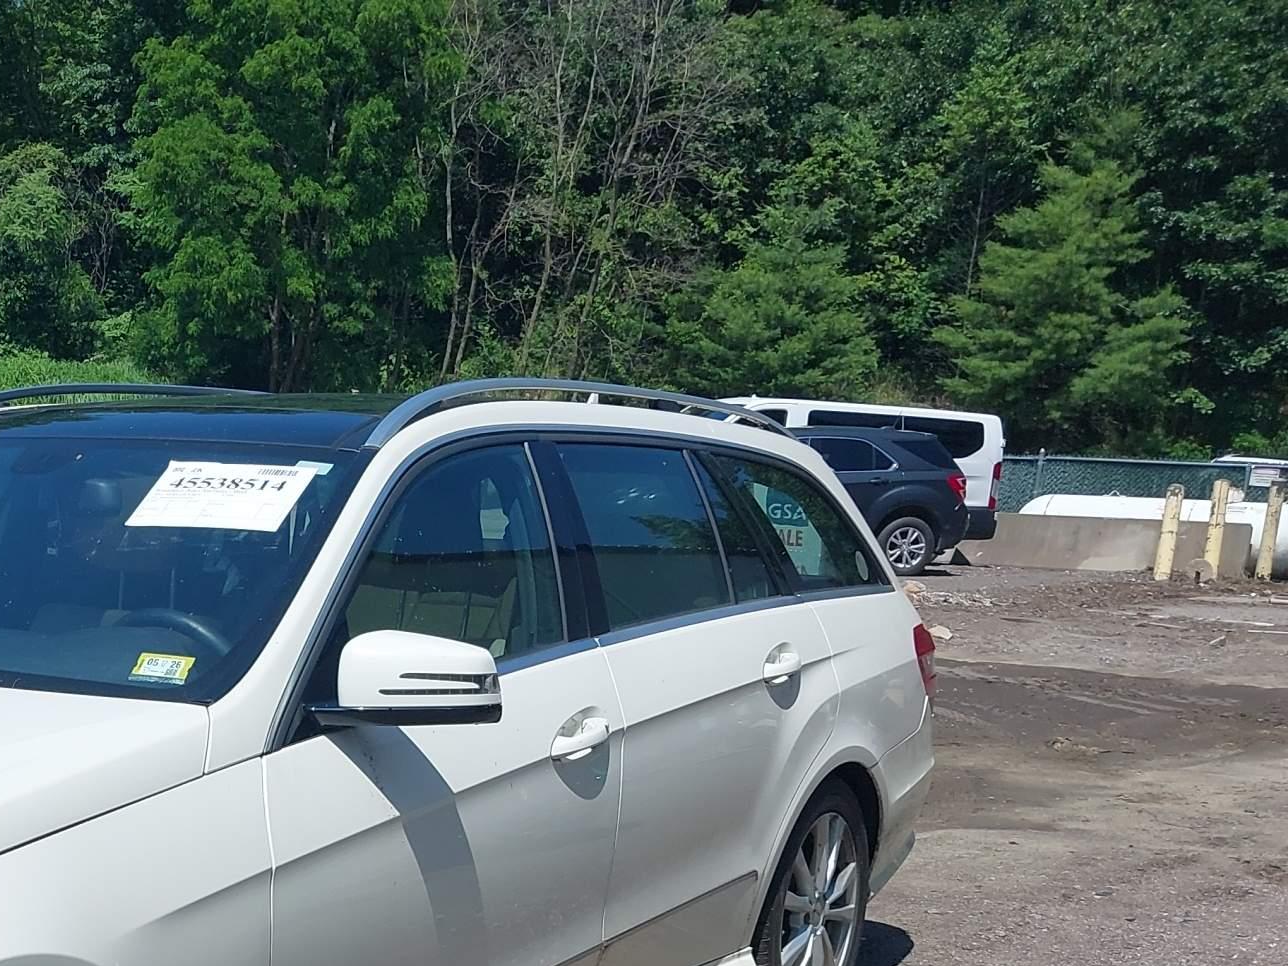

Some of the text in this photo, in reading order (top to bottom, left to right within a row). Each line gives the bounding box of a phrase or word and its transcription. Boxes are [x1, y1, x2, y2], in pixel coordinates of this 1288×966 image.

[169, 477, 288, 492] 45538514
[768, 503, 807, 520] GSA
[147, 658, 160, 667] 05
